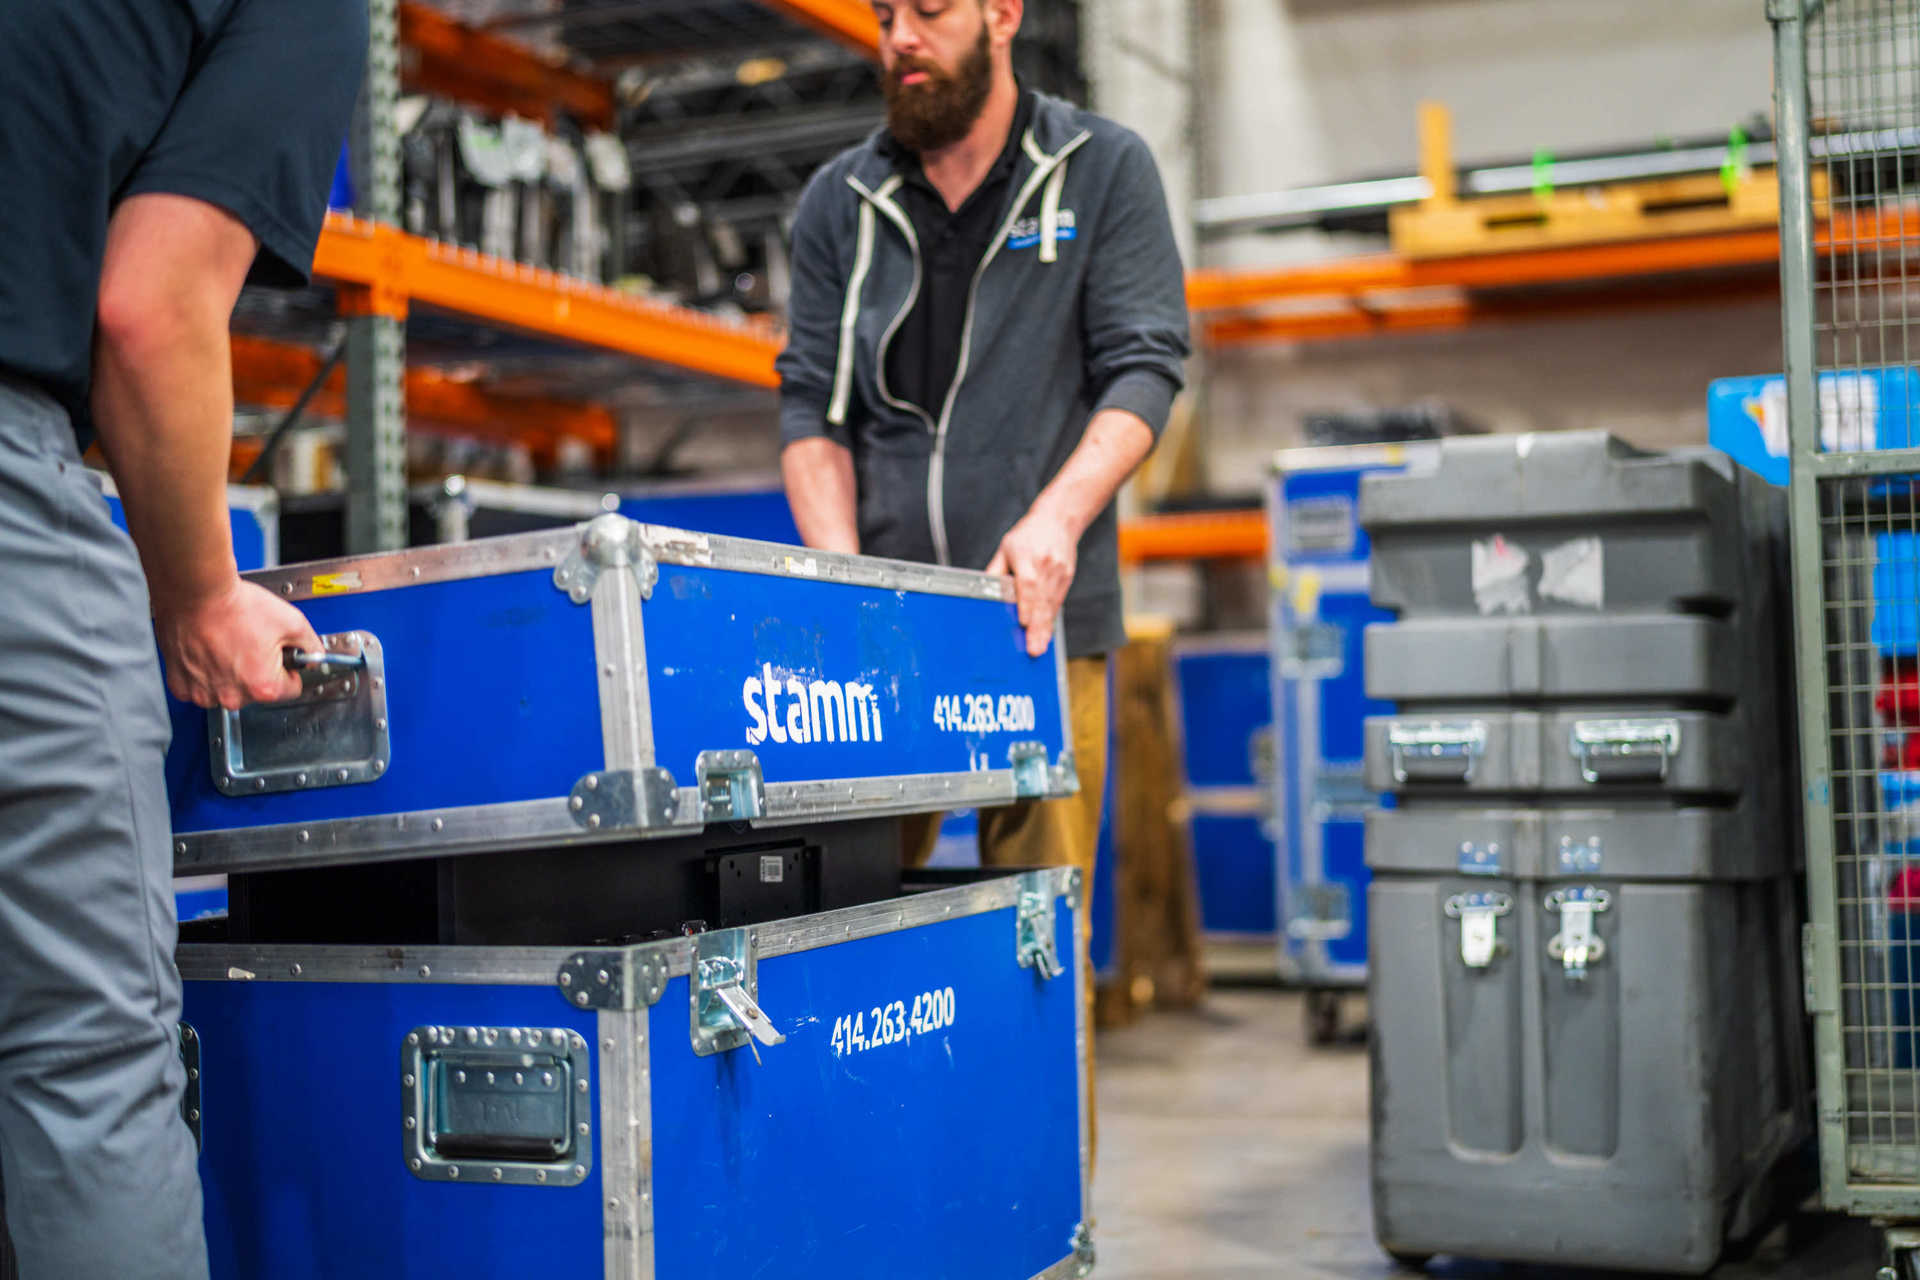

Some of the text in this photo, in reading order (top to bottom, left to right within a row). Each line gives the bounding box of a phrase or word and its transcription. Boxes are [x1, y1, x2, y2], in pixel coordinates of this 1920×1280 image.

[742, 661, 883, 745] stamm
[933, 693, 1035, 733] 414.263.4200
[831, 987, 955, 1058] 414.263.4200
